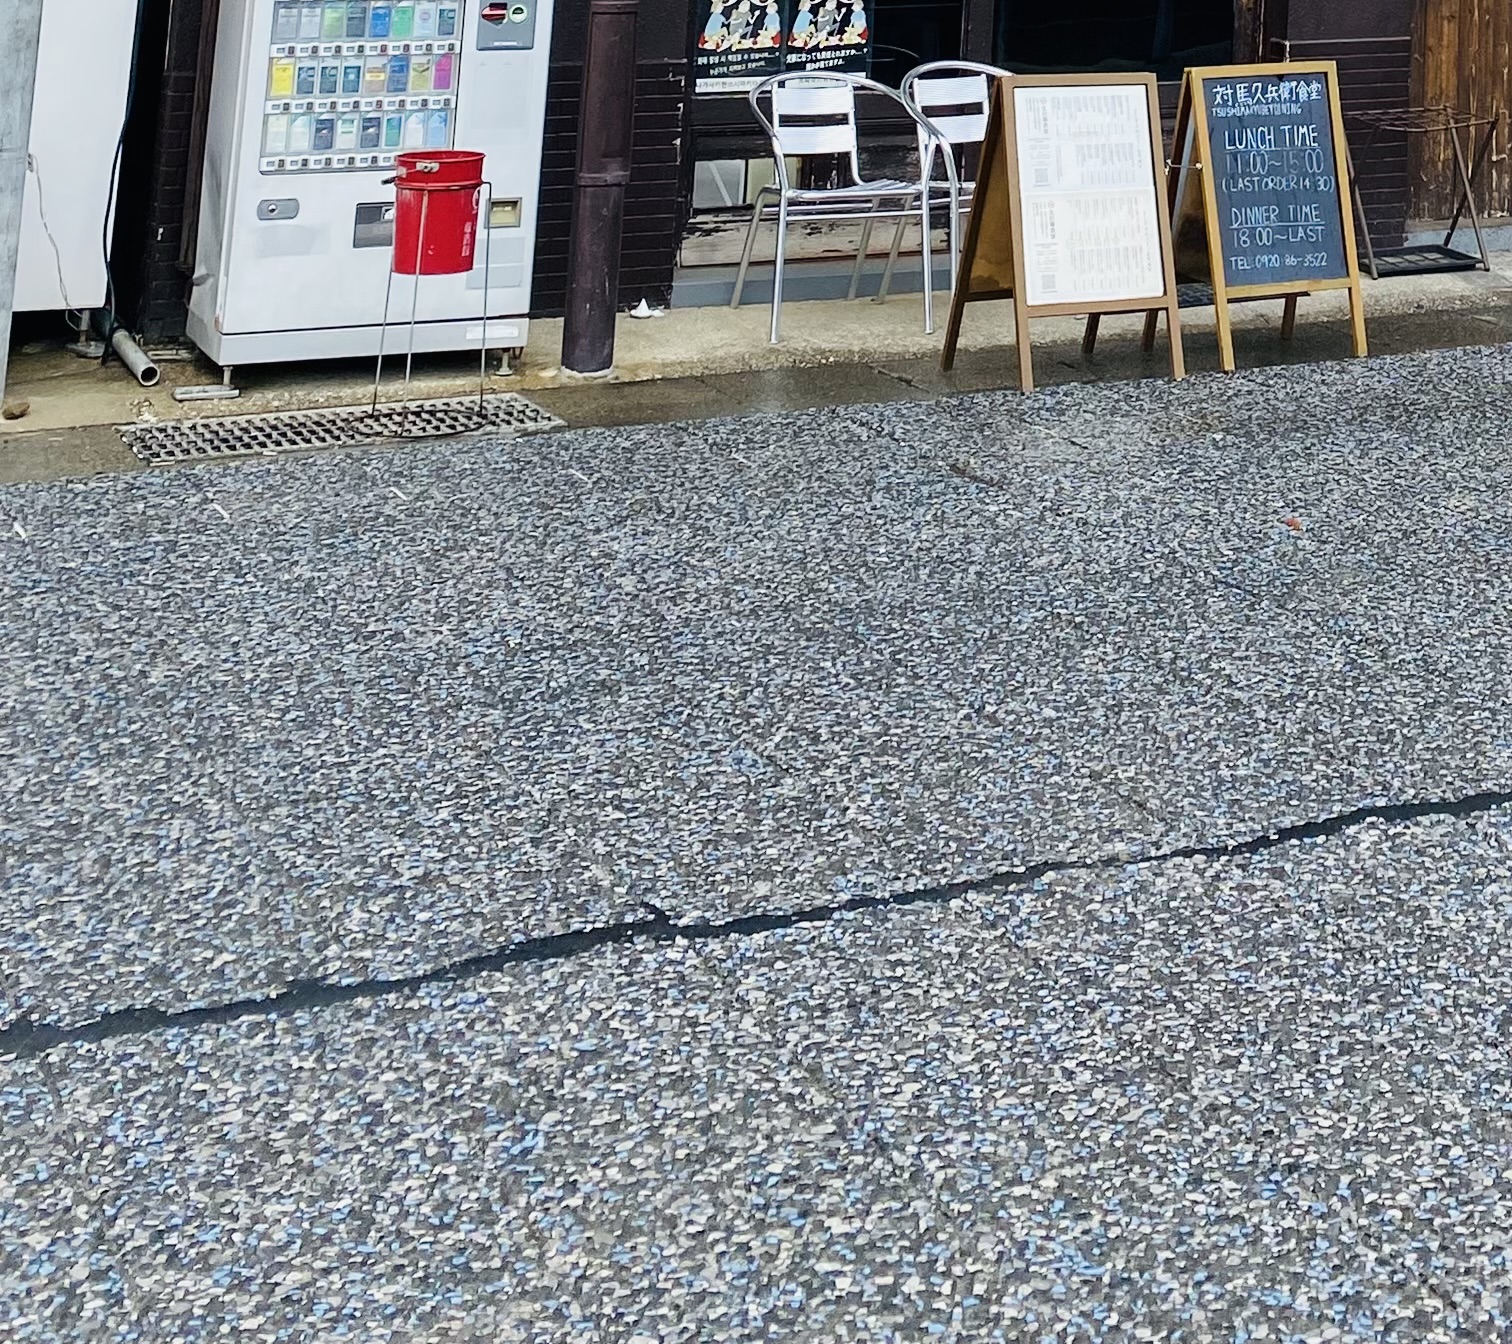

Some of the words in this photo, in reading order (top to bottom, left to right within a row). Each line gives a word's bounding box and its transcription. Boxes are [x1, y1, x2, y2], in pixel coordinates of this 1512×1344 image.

[1212, 80, 1322, 106] 対馬久兵衛食堂
[1224, 126, 1275, 150] LUNCH
[1280, 124, 1319, 148] TIME
[1231, 205, 1279, 227] DINNER
[1288, 204, 1321, 222] TIME
